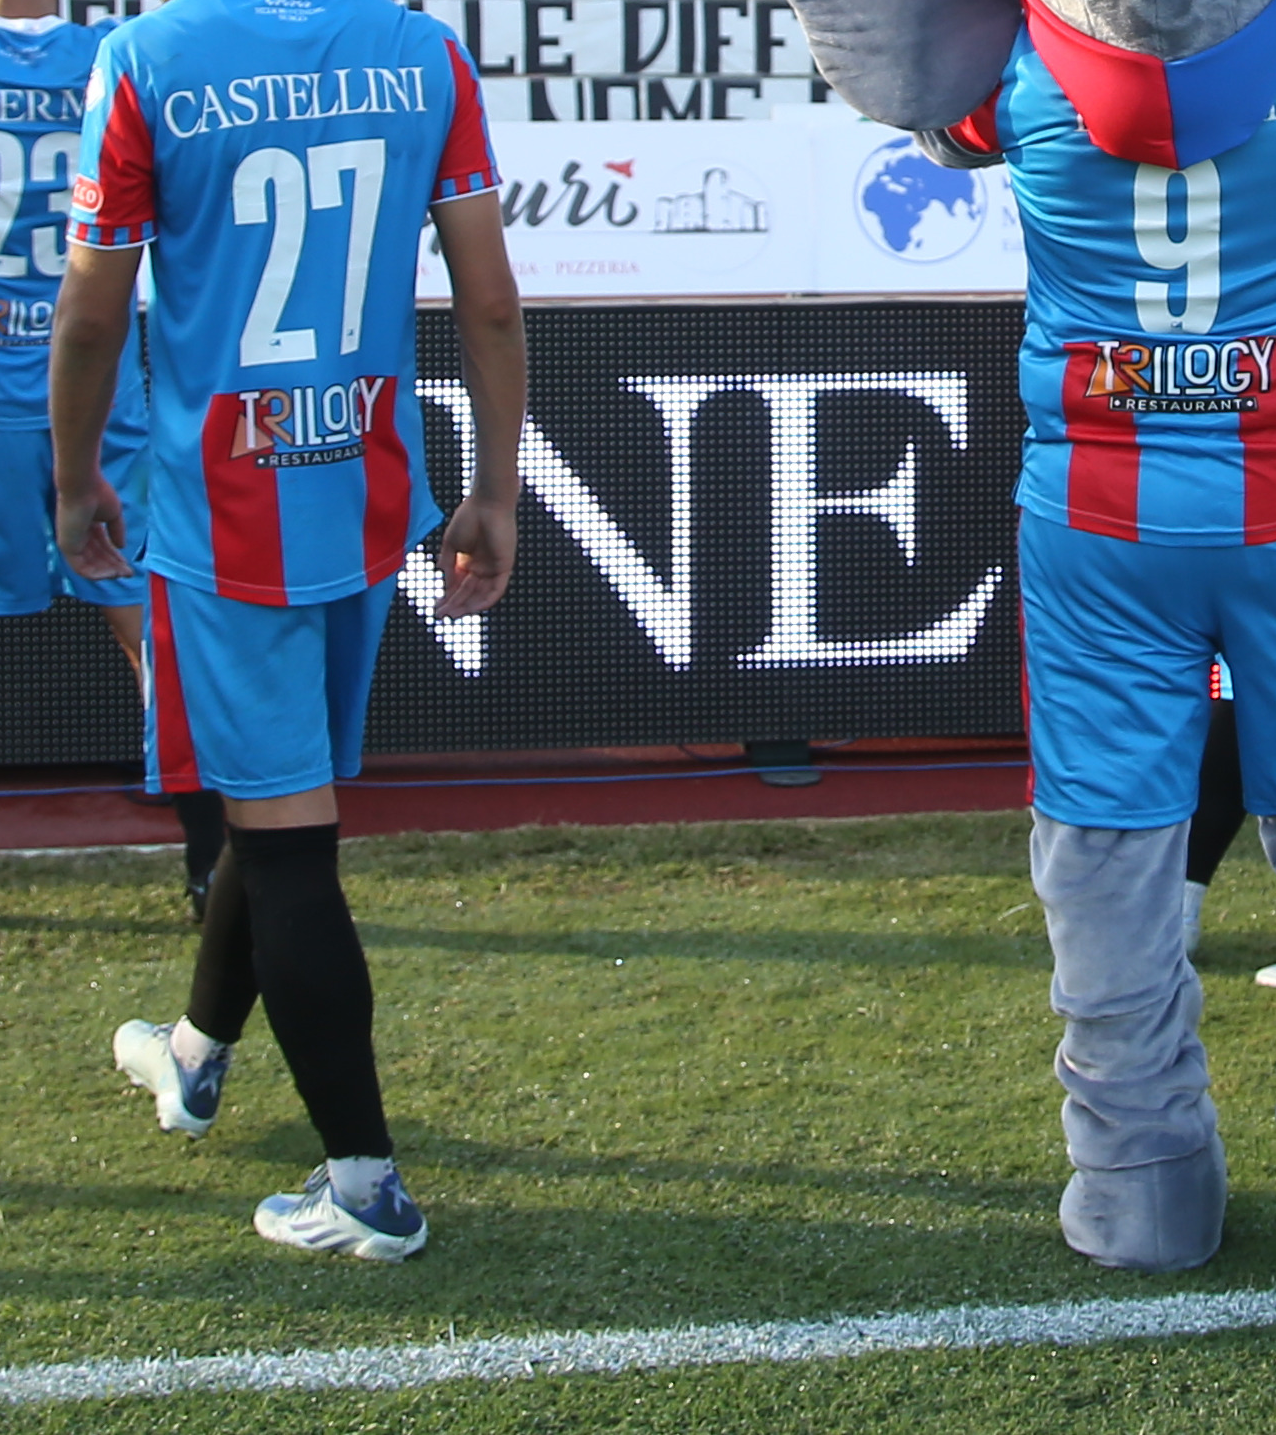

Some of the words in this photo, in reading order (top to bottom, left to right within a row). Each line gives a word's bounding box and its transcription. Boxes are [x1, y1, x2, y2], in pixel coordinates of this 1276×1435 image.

[164, 66, 428, 139] CASTELLINI
[231, 138, 387, 367] 27
[1133, 158, 1222, 335] 9
[237, 376, 386, 450] TRILOGY
[1125, 397, 1243, 412] RESTAURANT
